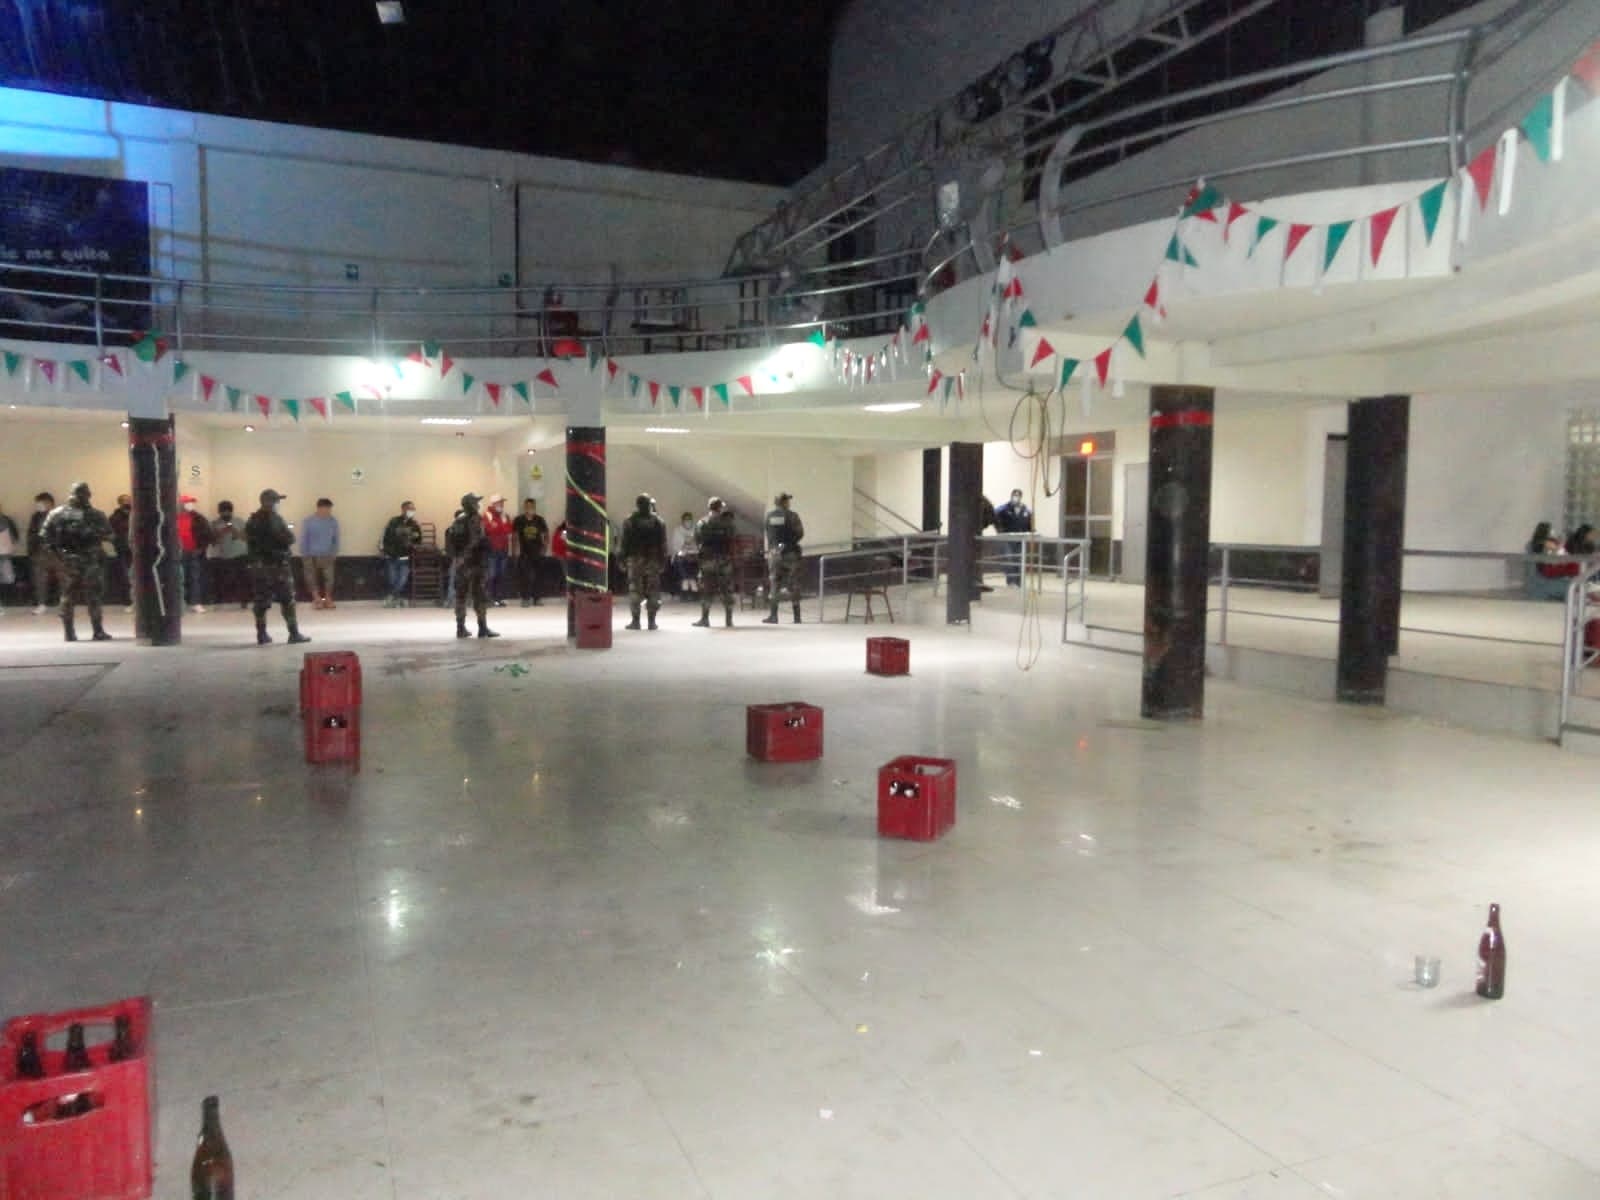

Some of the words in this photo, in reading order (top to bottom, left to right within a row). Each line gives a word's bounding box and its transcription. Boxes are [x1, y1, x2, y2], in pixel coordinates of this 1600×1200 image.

[25, 249, 54, 261] me
[61, 245, 110, 262] quita
[191, 465, 201, 478] S
